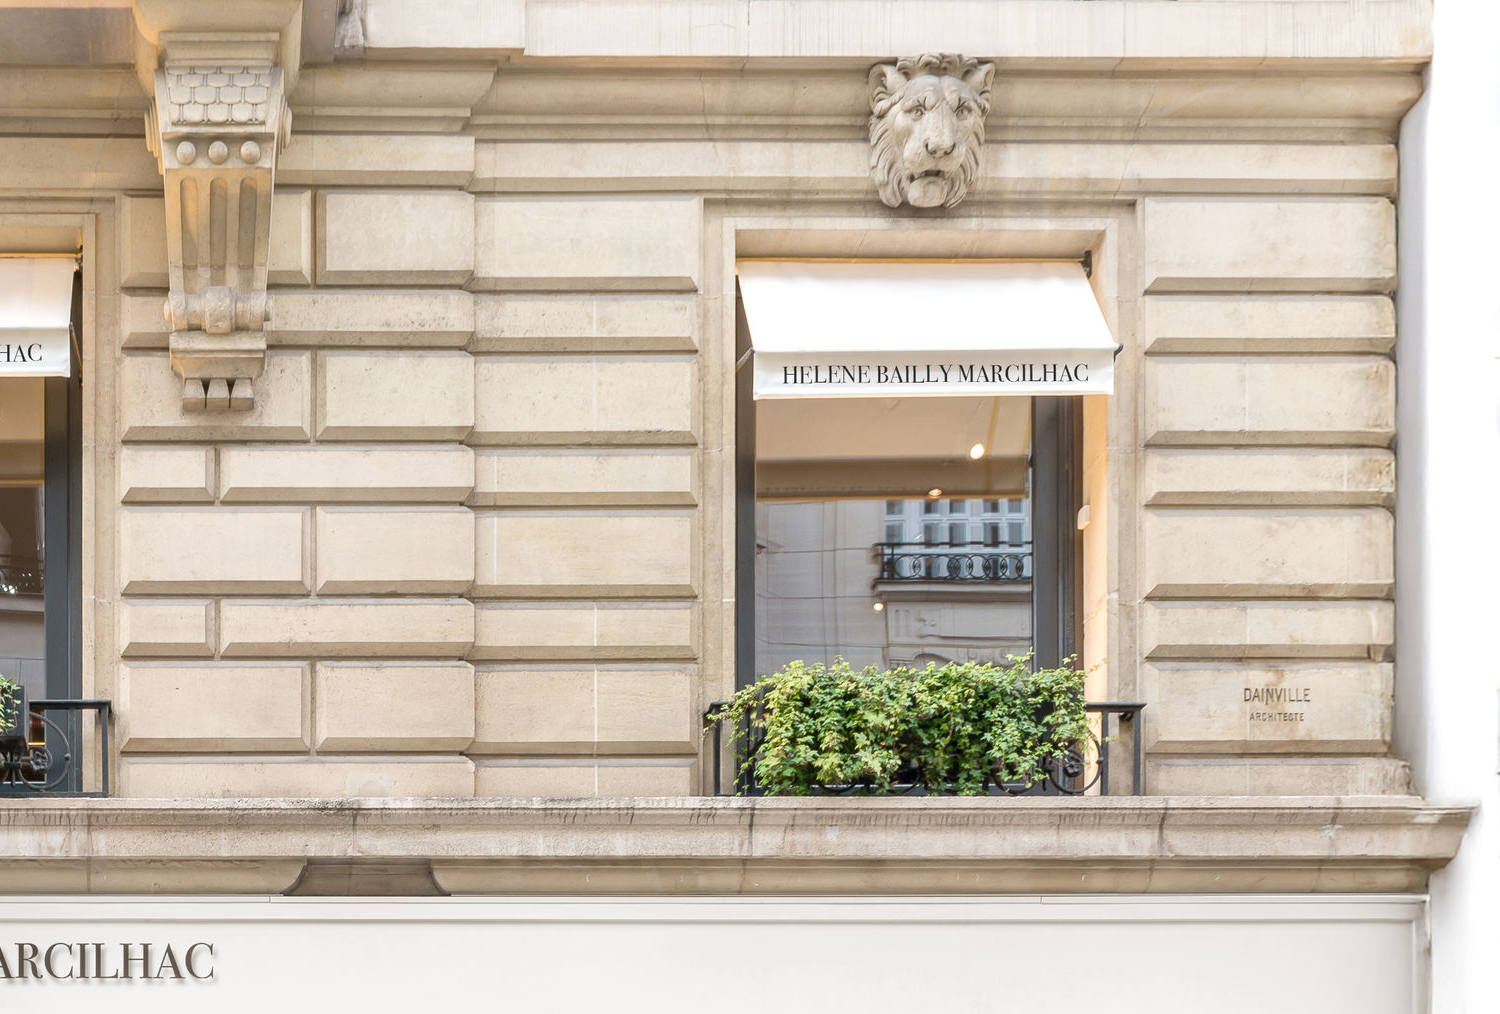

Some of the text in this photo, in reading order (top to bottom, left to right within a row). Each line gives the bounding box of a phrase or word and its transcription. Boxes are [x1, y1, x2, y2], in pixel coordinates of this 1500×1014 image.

[782, 363, 1089, 384] HELENE BAILLY MARCILHAC
[1243, 687, 1311, 703] DAINVILLE
[1249, 712, 1305, 722] ARCHITECTE
